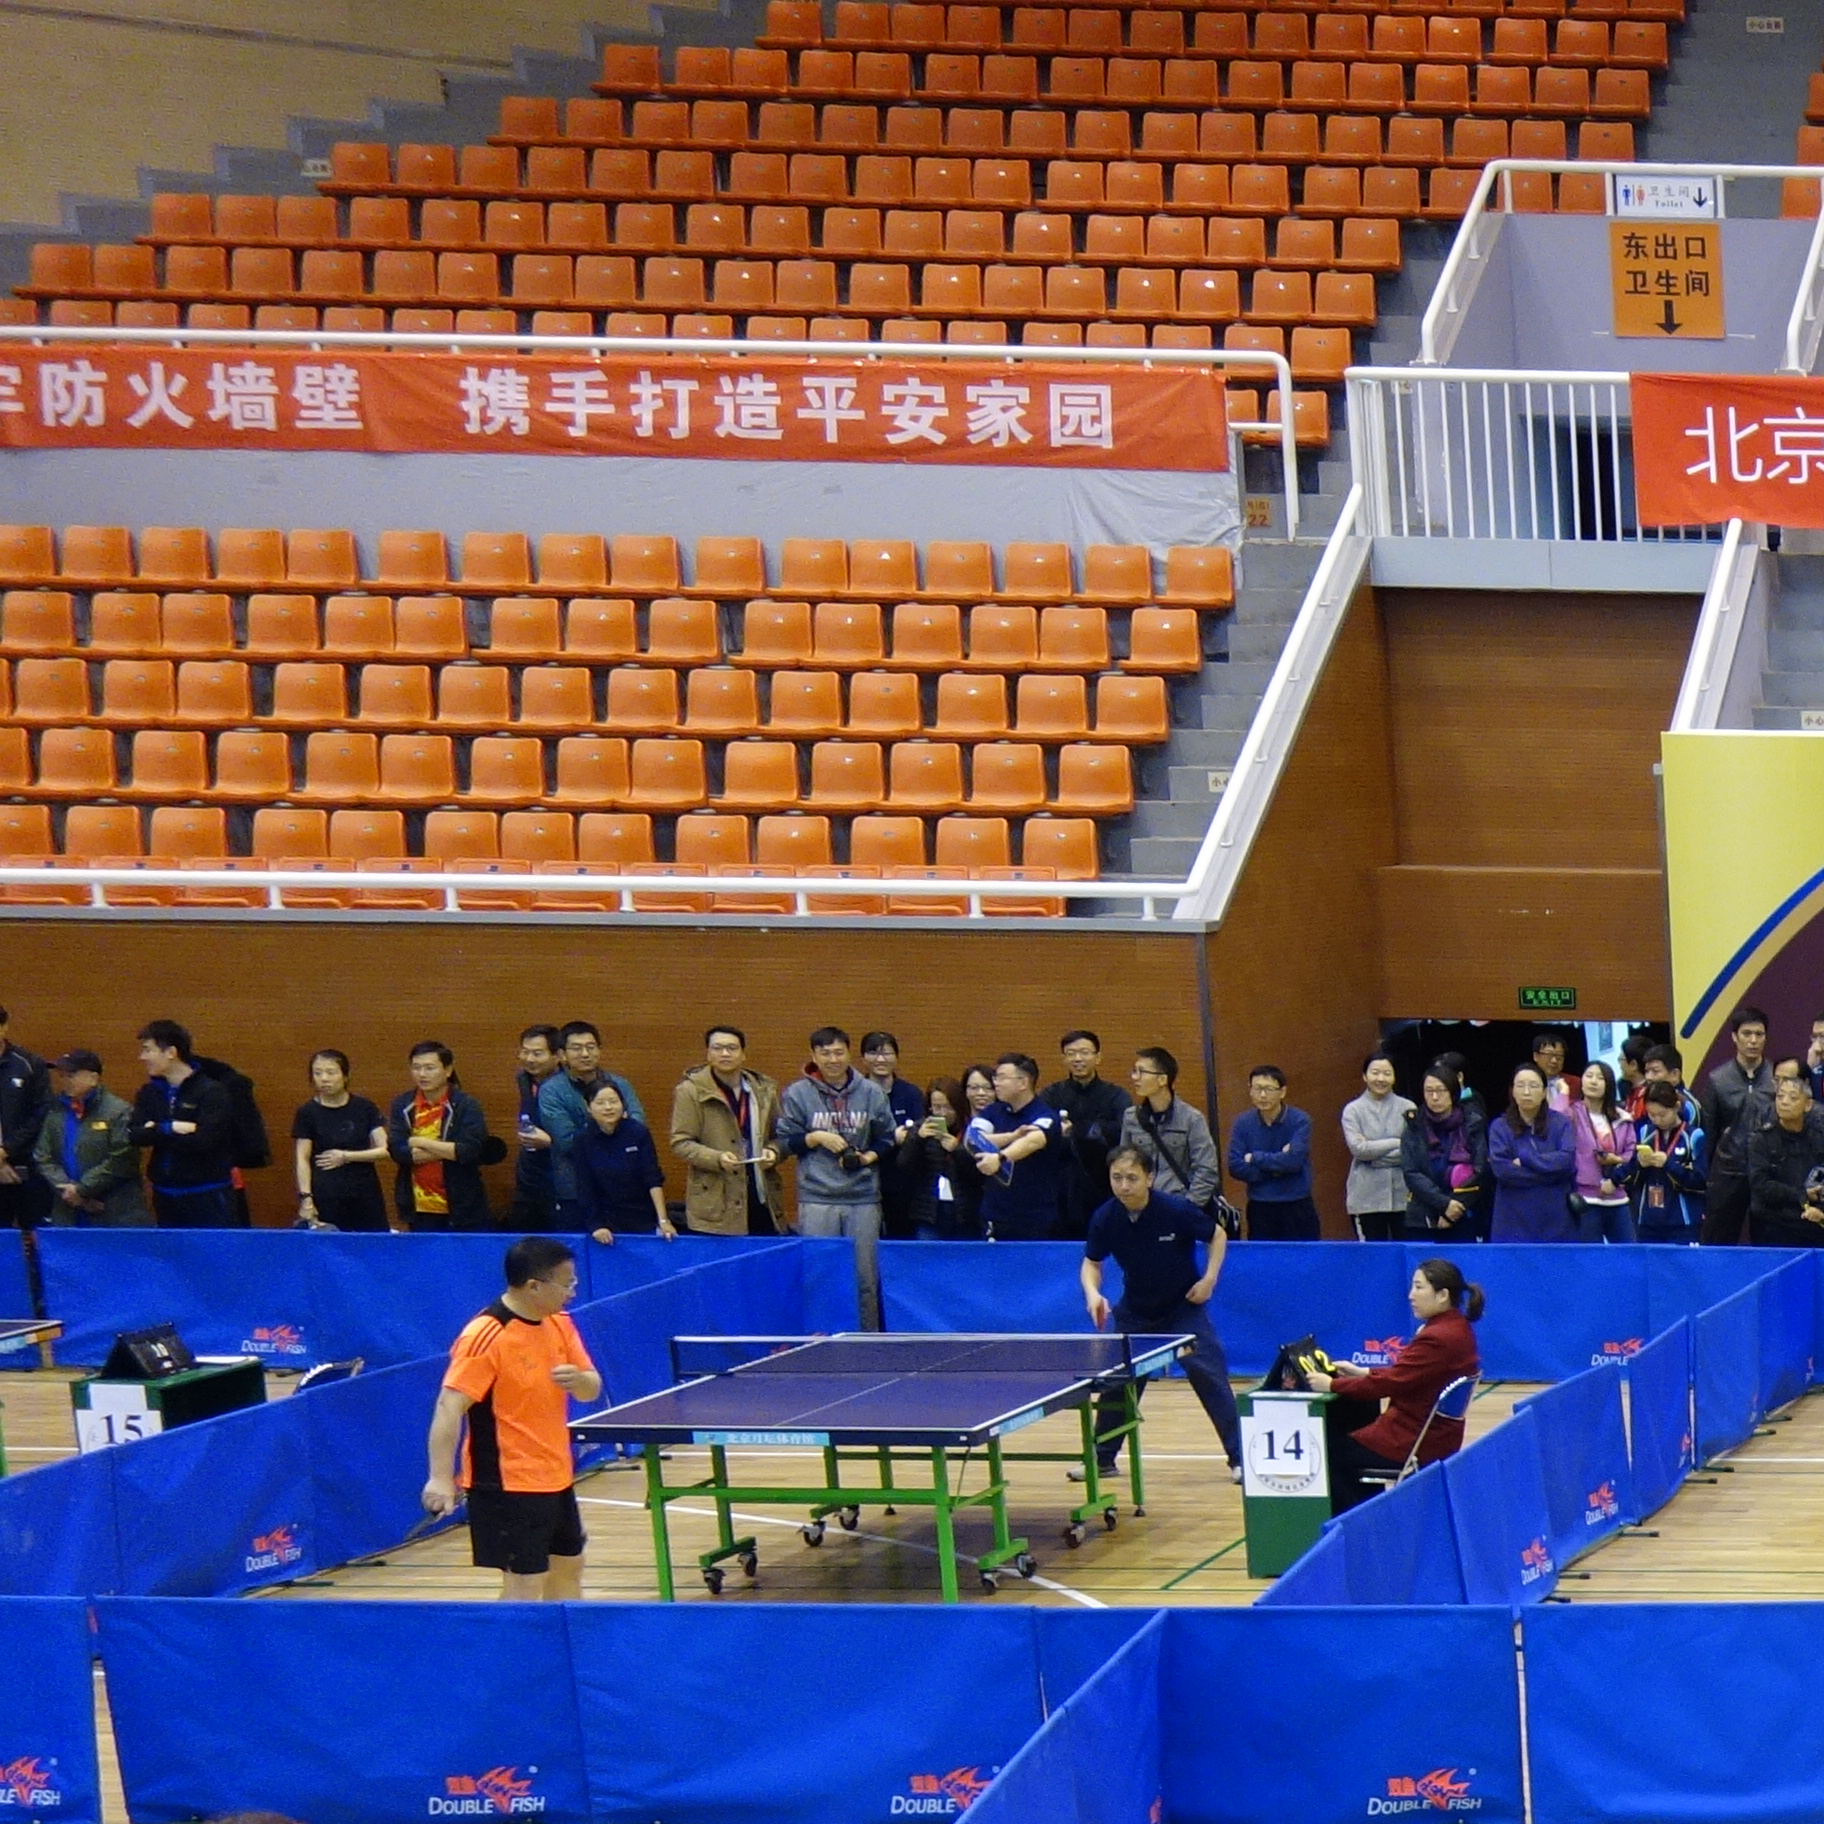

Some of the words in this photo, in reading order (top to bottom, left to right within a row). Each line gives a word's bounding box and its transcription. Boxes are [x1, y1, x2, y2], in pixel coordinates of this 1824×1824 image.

[1648, 185, 1689, 198] 卫生间
[1622, 232, 1707, 260] 东出口
[1624, 269, 1709, 297] 卫生间
[459, 366, 1114, 450] 携手打造平安家园
[100, 1414, 143, 1446] 15
[1263, 1430, 1304, 1461] 14
[246, 1554, 278, 1573] DOUBLE
[31, 1789, 61, 1805] FISH
[428, 1796, 494, 1815] DOUBLE
[510, 1796, 545, 1813] FISH
[891, 1797, 955, 1814] DOUBLE
[1367, 1799, 1432, 1815] DOUBLE
[1449, 1797, 1482, 1811] FISH
